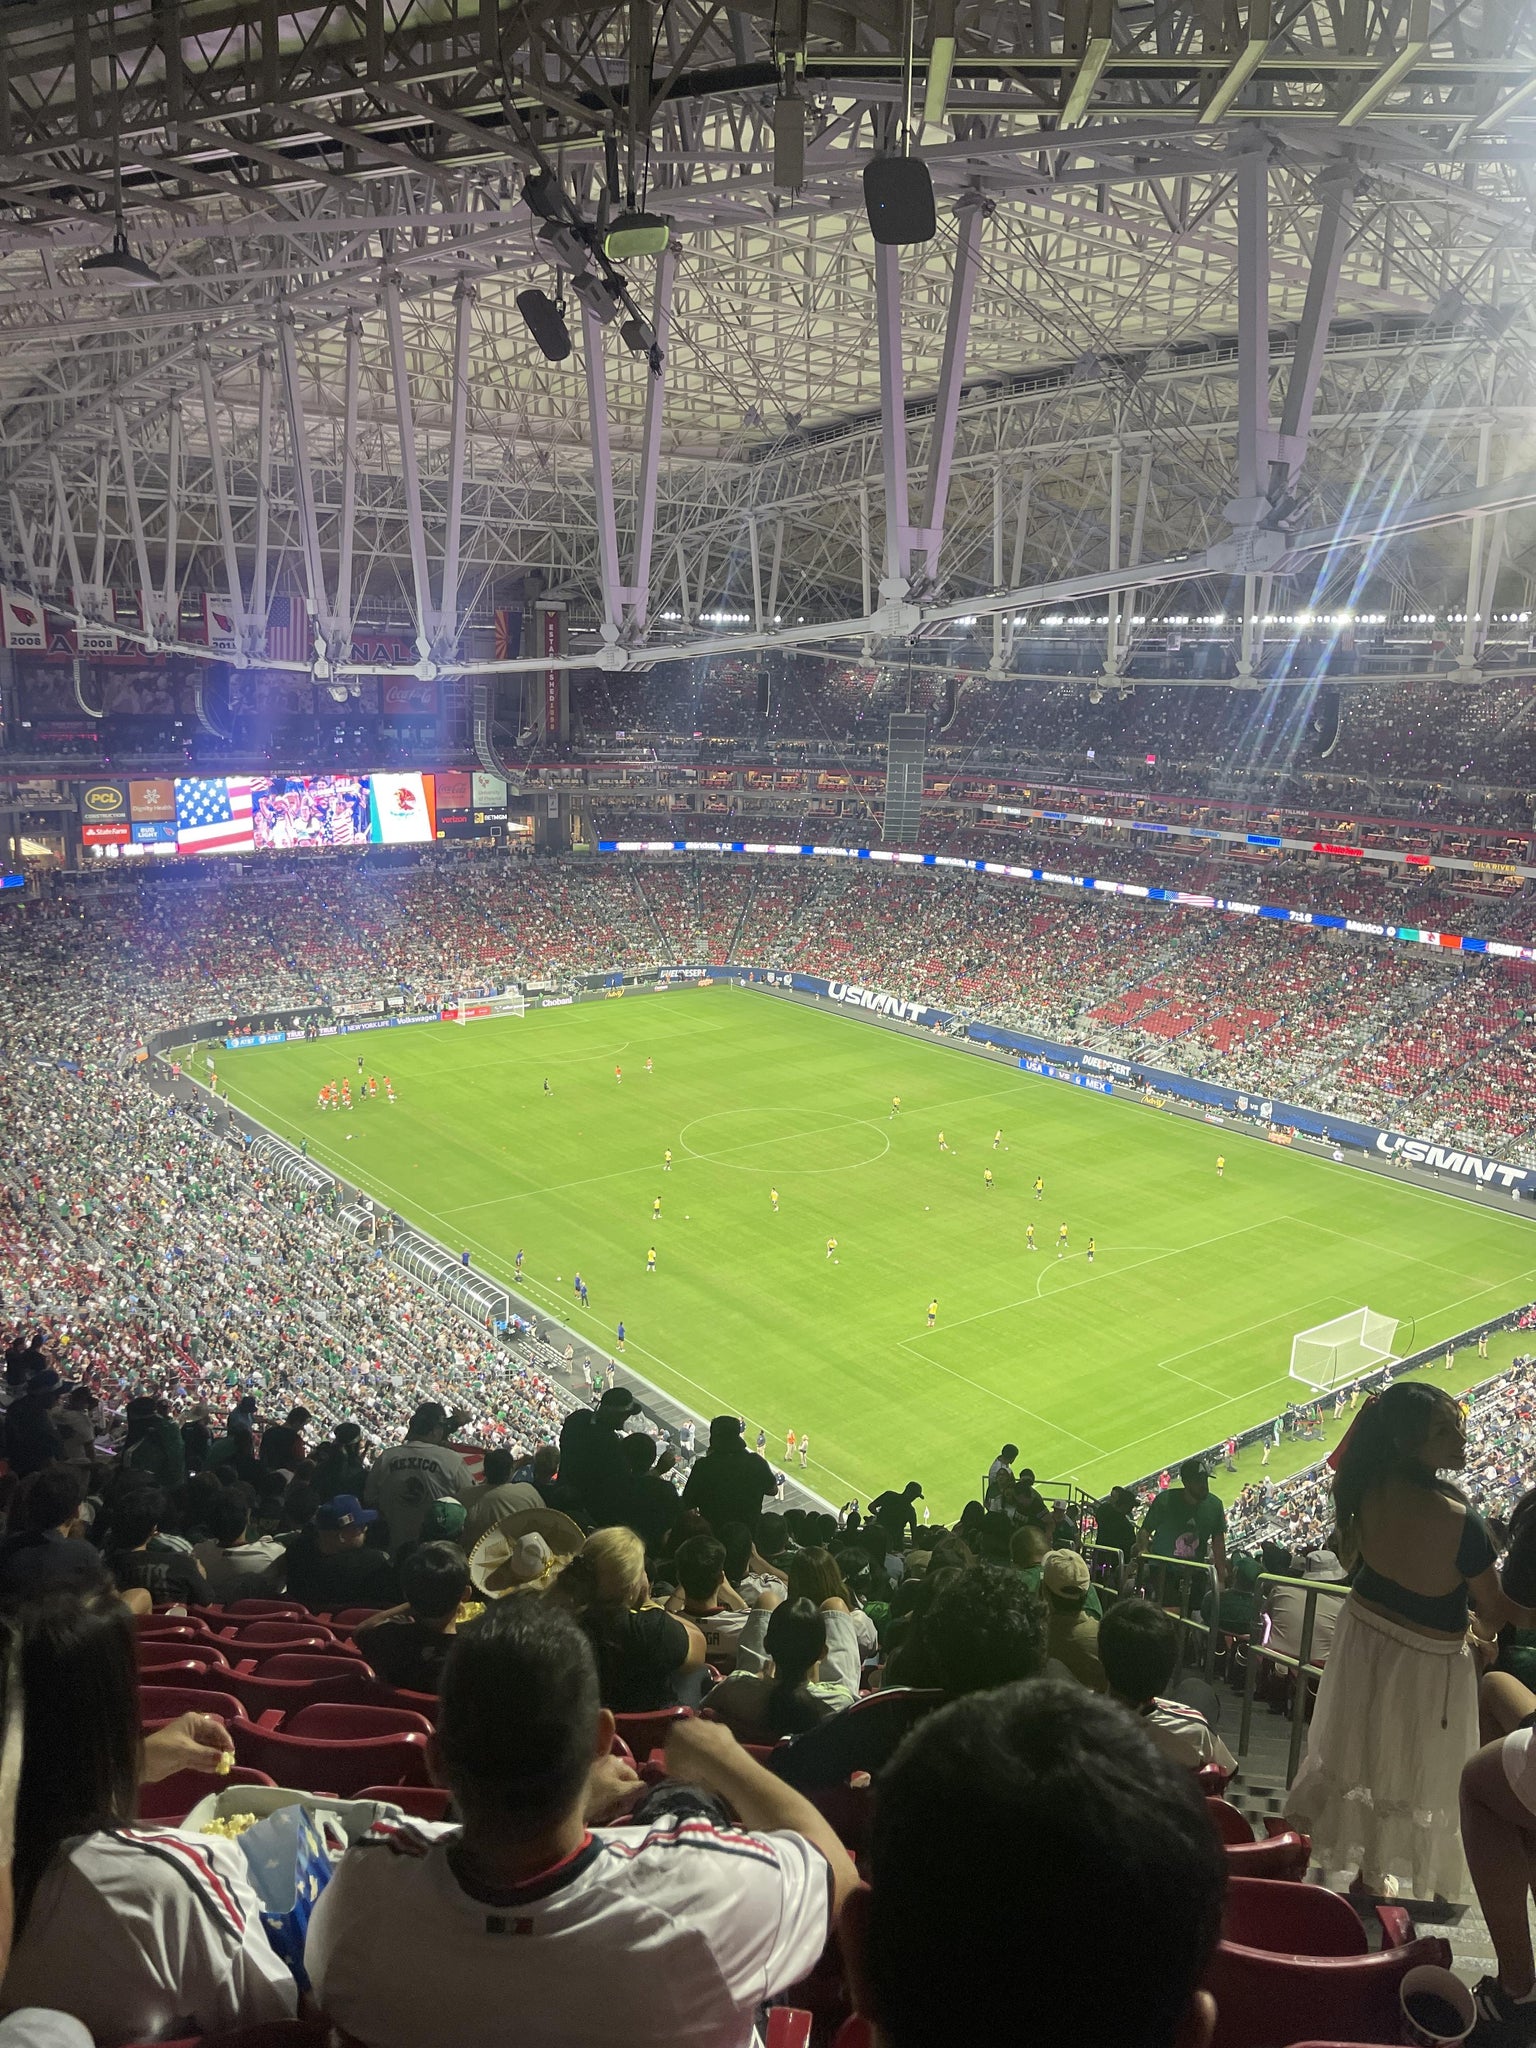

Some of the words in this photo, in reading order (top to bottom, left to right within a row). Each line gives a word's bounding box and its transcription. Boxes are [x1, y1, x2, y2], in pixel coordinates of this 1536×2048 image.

[10, 637, 41, 646] 2008
[83, 639, 113, 648] 2008
[91, 793, 117, 804] PCL
[1083, 815, 1106, 826] SAFEWAY
[1473, 861, 1491, 870] GILA
[1492, 863, 1517, 872] RIVER
[1289, 910, 1312, 923] 7:16
[1346, 919, 1384, 935] Mexico
[542, 996, 573, 1008] Chobani
[828, 982, 928, 1022] USMNT
[397, 1014, 437, 1025] Volkswagen
[347, 1023, 362, 1031] NEW
[362, 1021, 377, 1030] YORK
[240, 1038, 255, 1046] AT&T
[267, 1034, 282, 1042] AT&T
[1025, 1060, 1043, 1074] USA
[1085, 1079, 1106, 1093] MEX
[1376, 1132, 1528, 1187] USMNT
[389, 1456, 439, 1475] MEXICO
